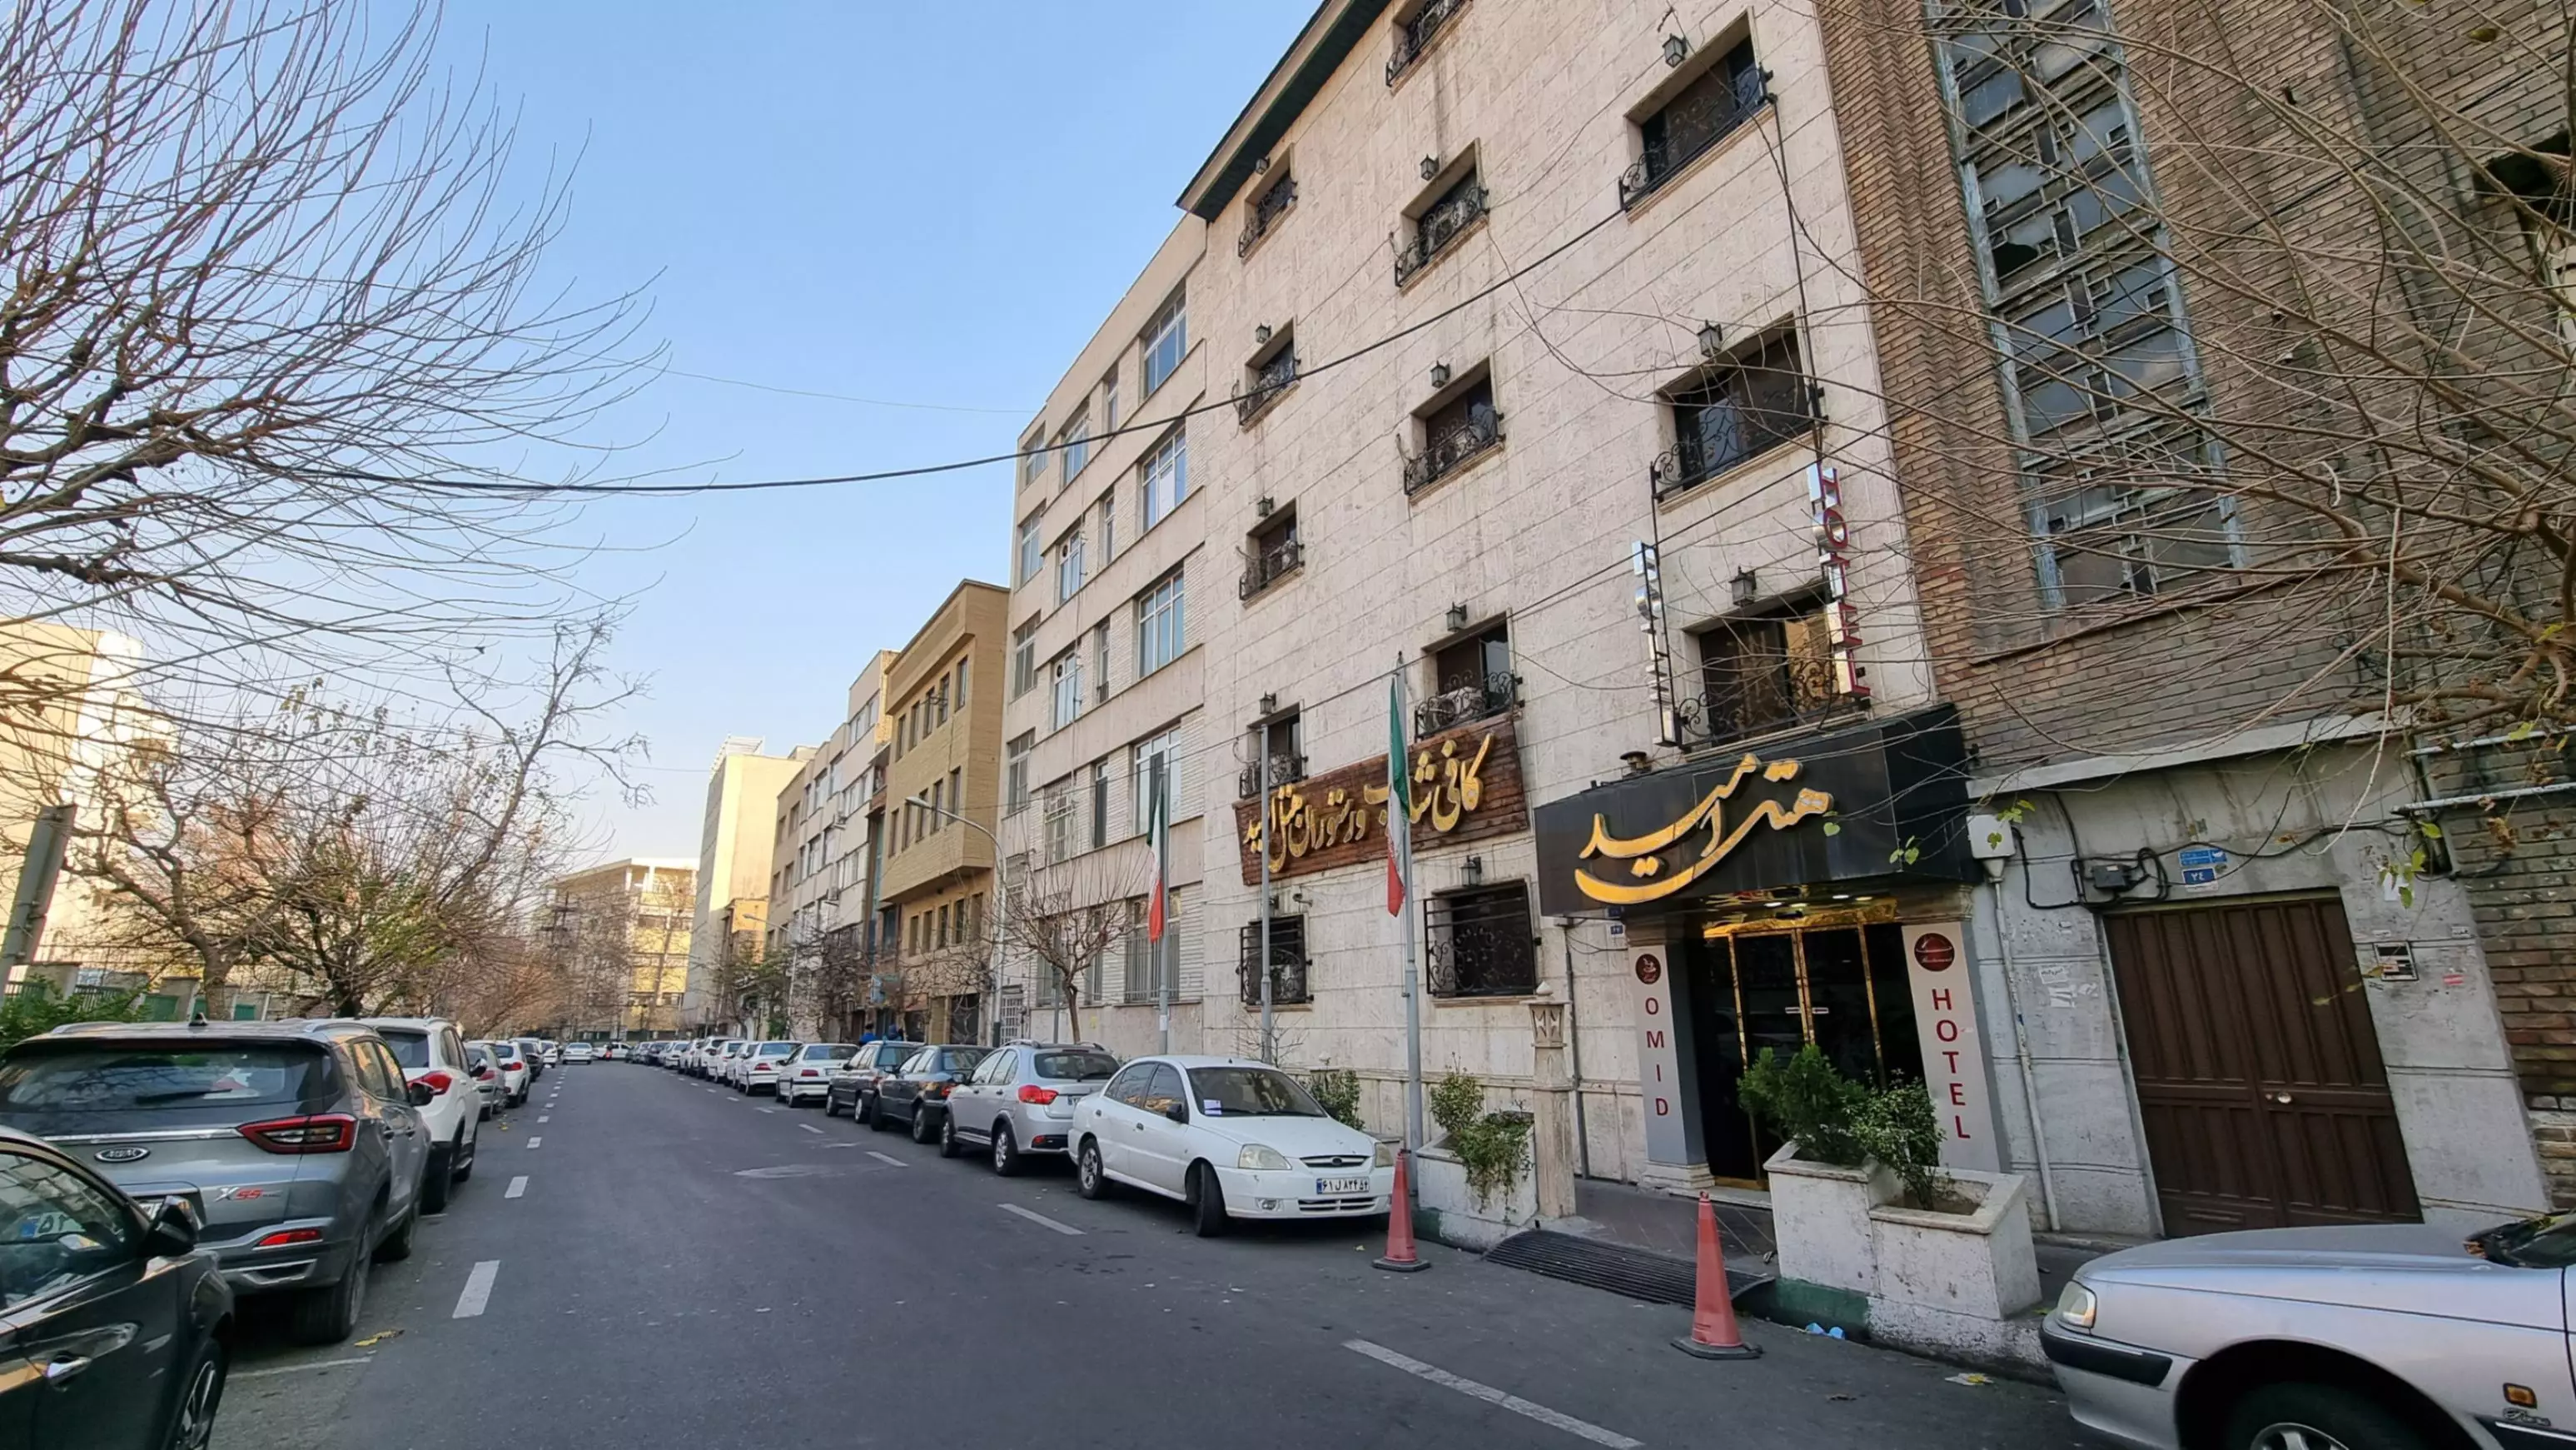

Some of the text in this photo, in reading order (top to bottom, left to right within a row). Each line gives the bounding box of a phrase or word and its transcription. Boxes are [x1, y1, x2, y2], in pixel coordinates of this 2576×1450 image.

[1268, 784, 1303, 874] هتل
[1289, 788, 1356, 858] رستوران
[1432, 733, 1494, 832] کافی
[1574, 752, 1834, 904] هتل امید
[1644, 997, 1668, 1116] OMID
[1931, 988, 1972, 1140] HOTEL
